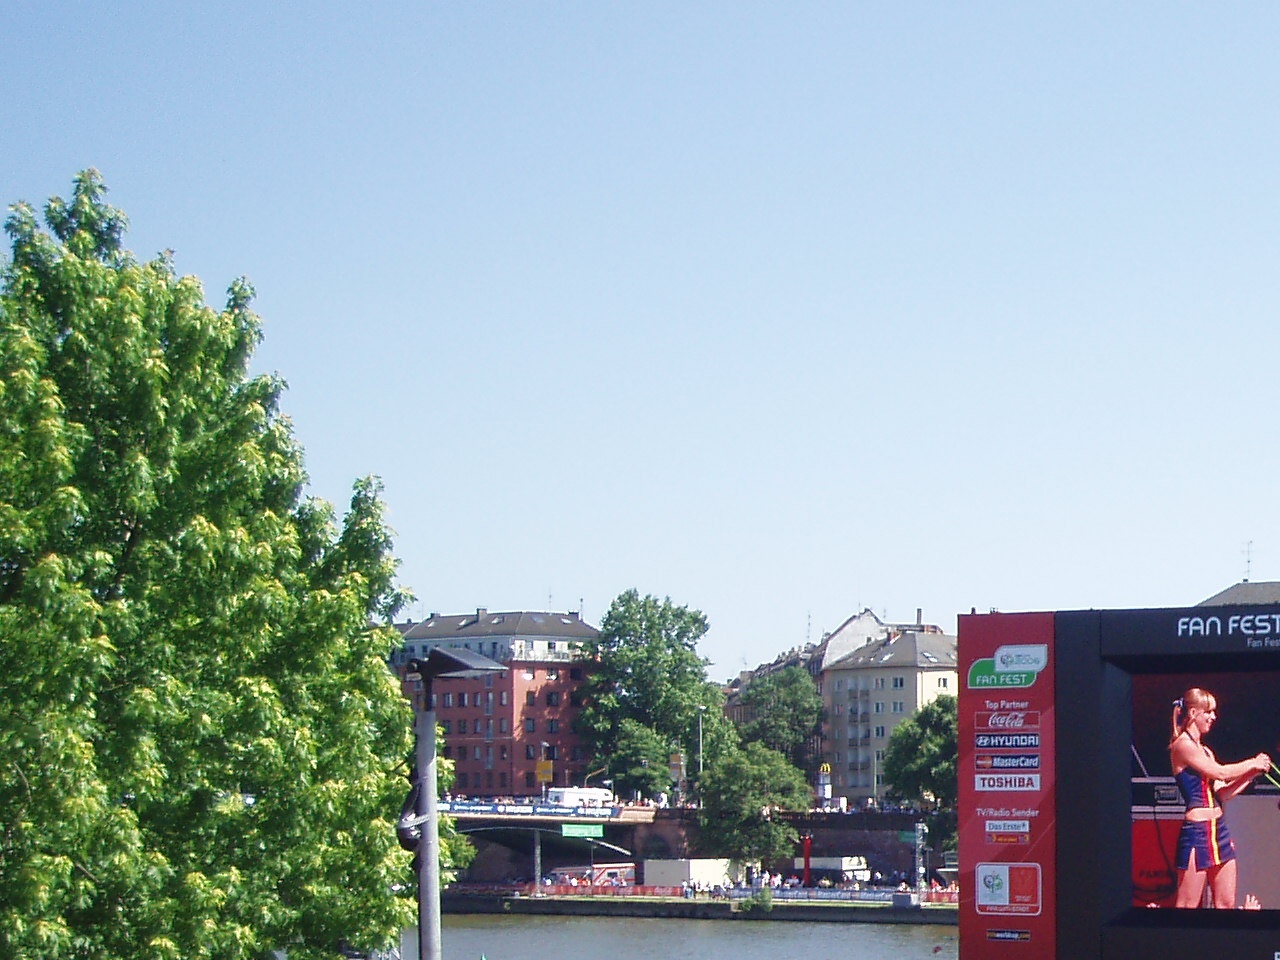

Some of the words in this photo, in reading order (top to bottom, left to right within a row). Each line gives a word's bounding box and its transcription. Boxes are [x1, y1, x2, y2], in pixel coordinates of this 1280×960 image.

[1178, 616, 1221, 636] FAN
[1247, 637, 1262, 647] Fan
[976, 675, 997, 685] FAN
[1000, 674, 1027, 685] FEST
[985, 700, 999, 709] Top
[1000, 700, 1029, 709] Partner
[991, 735, 1039, 746] HYUNDAI
[993, 757, 1038, 767] MasterCard
[980, 777, 1035, 788] TOSHIBA
[976, 808, 1010, 817] TV/Radio
[1012, 808, 1039, 817] Sender
